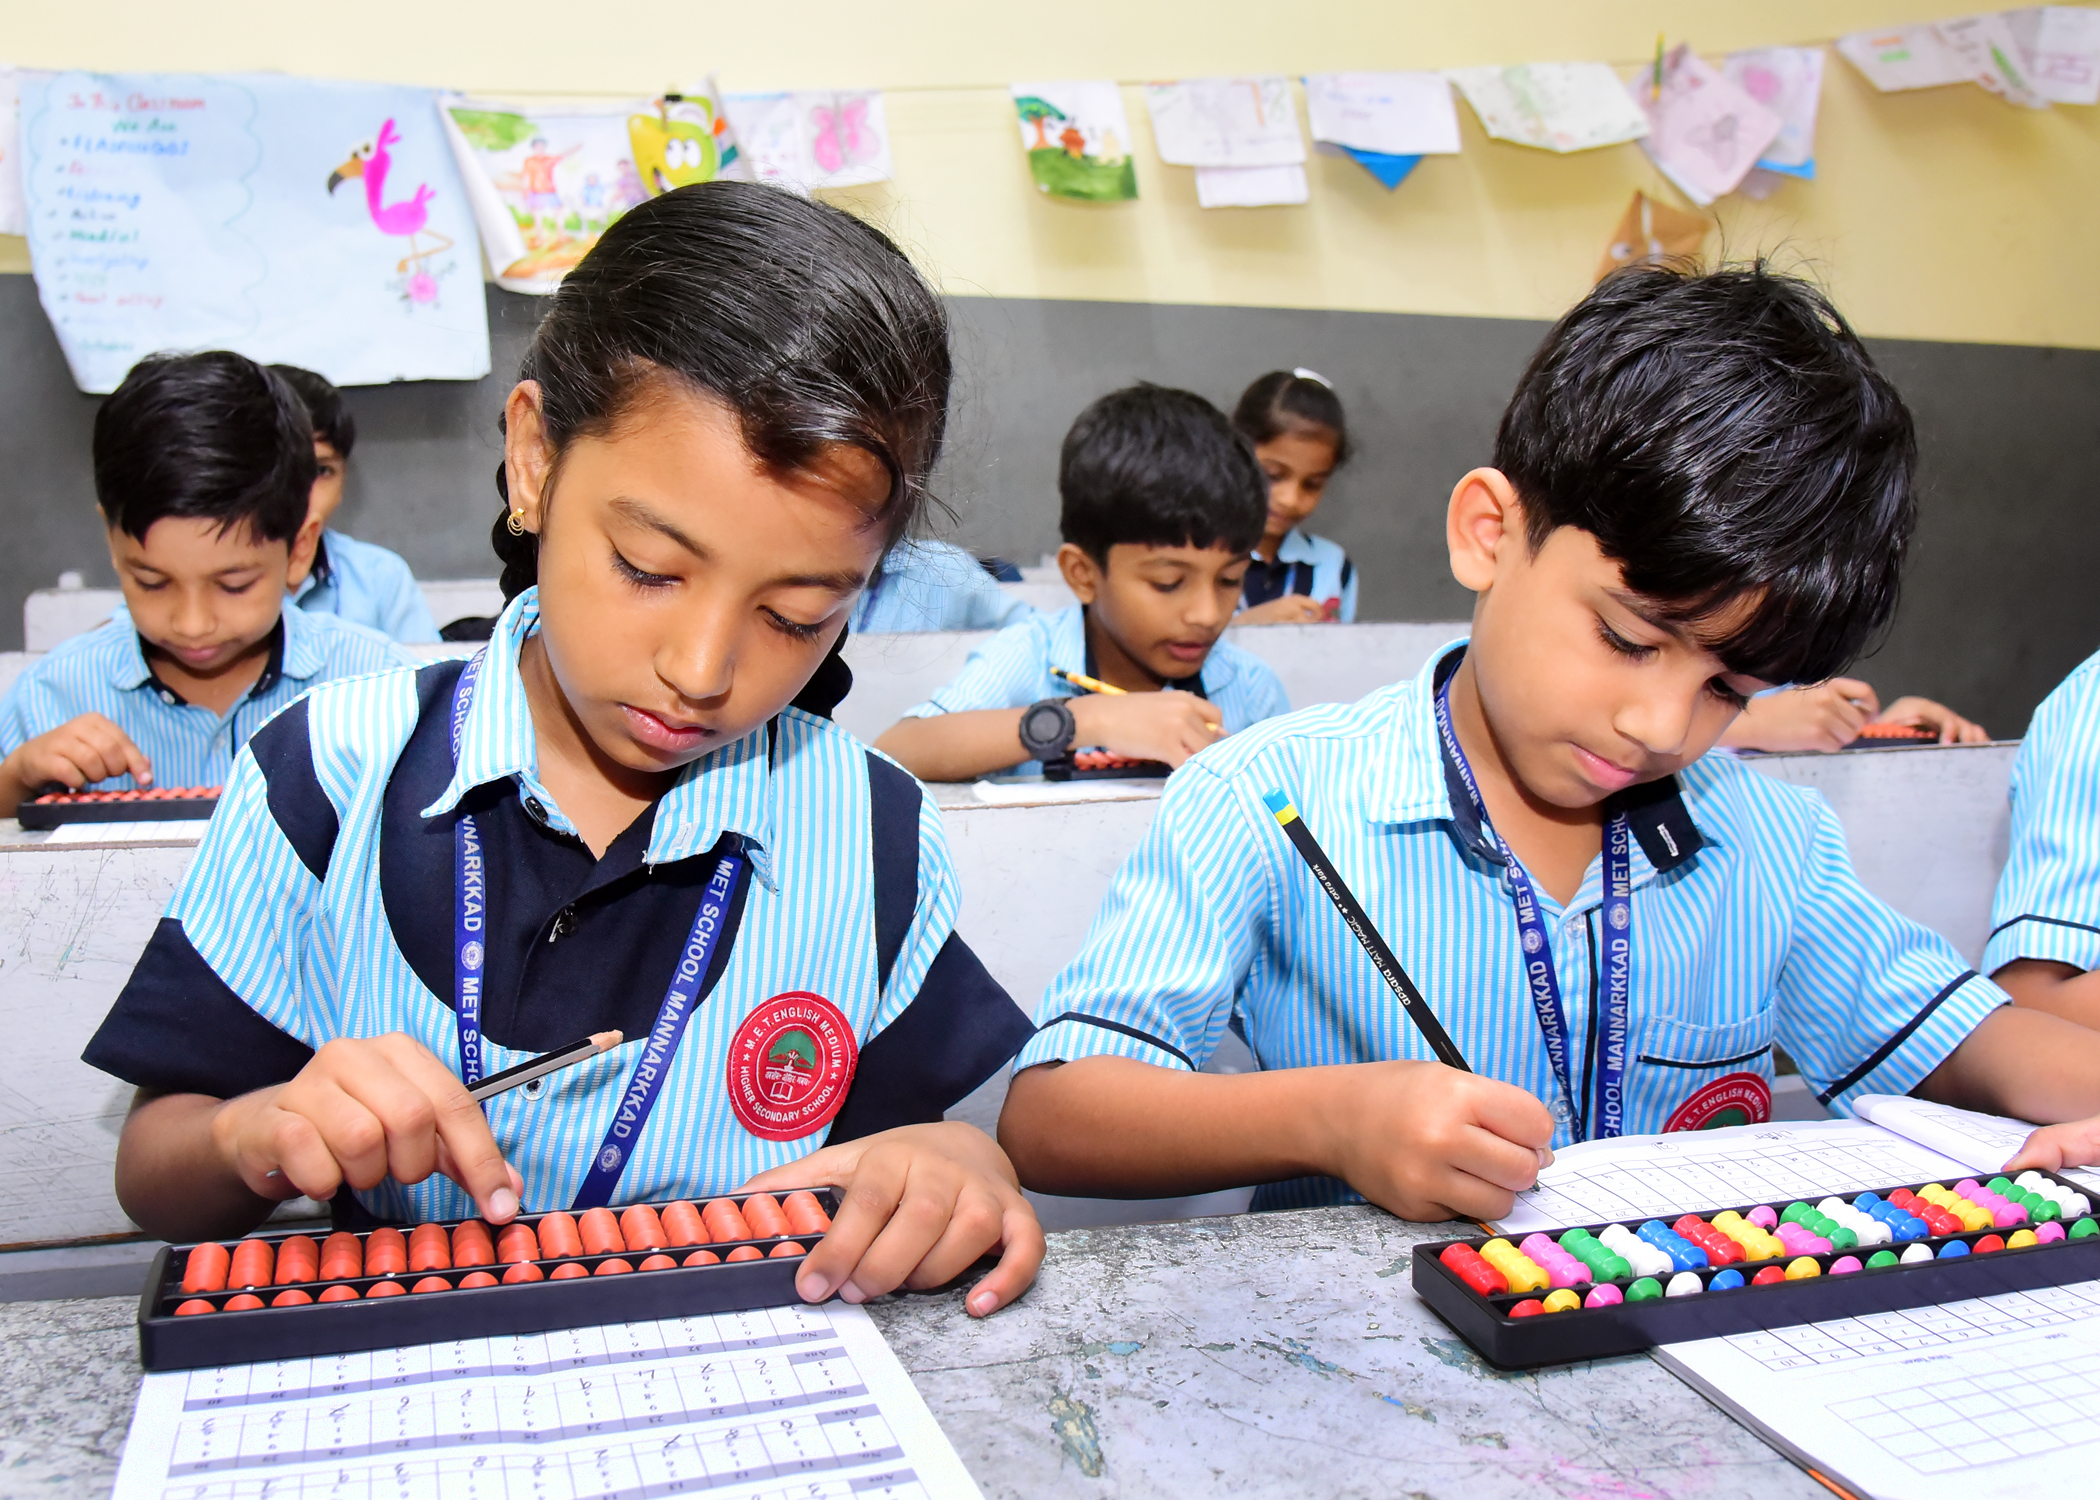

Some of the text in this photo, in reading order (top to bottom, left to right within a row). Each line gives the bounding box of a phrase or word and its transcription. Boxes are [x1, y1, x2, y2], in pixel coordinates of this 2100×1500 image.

[126, 92, 205, 113] Classroom
[112, 117, 176, 132] We Are
[464, 648, 487, 681] MET
[1610, 861, 1629, 898] MET
[1516, 885, 1536, 924] MET
[1312, 863, 1412, 1006] apsara MATT MAGIC extra dark
[462, 977, 480, 1023] MET
[612, 859, 734, 1139] MET SCHOOL MANNARKKAD
[1606, 938, 1628, 1072] MANNARKKAD
[1530, 960, 1569, 1090] MANNARKKAD
[819, 1020, 842, 1068] MEDIUM
[740, 1066, 756, 1104] HIGHER
[752, 1102, 800, 1122] SECONDARY
[802, 1084, 835, 1116] SCHOOL
[1744, 1089, 1765, 1120] MEDIUM
[579, 1378, 592, 1389] 9
[648, 1415, 664, 1424] 23
[710, 1408, 725, 1416] 22
[834, 1408, 858, 1416] Ans
